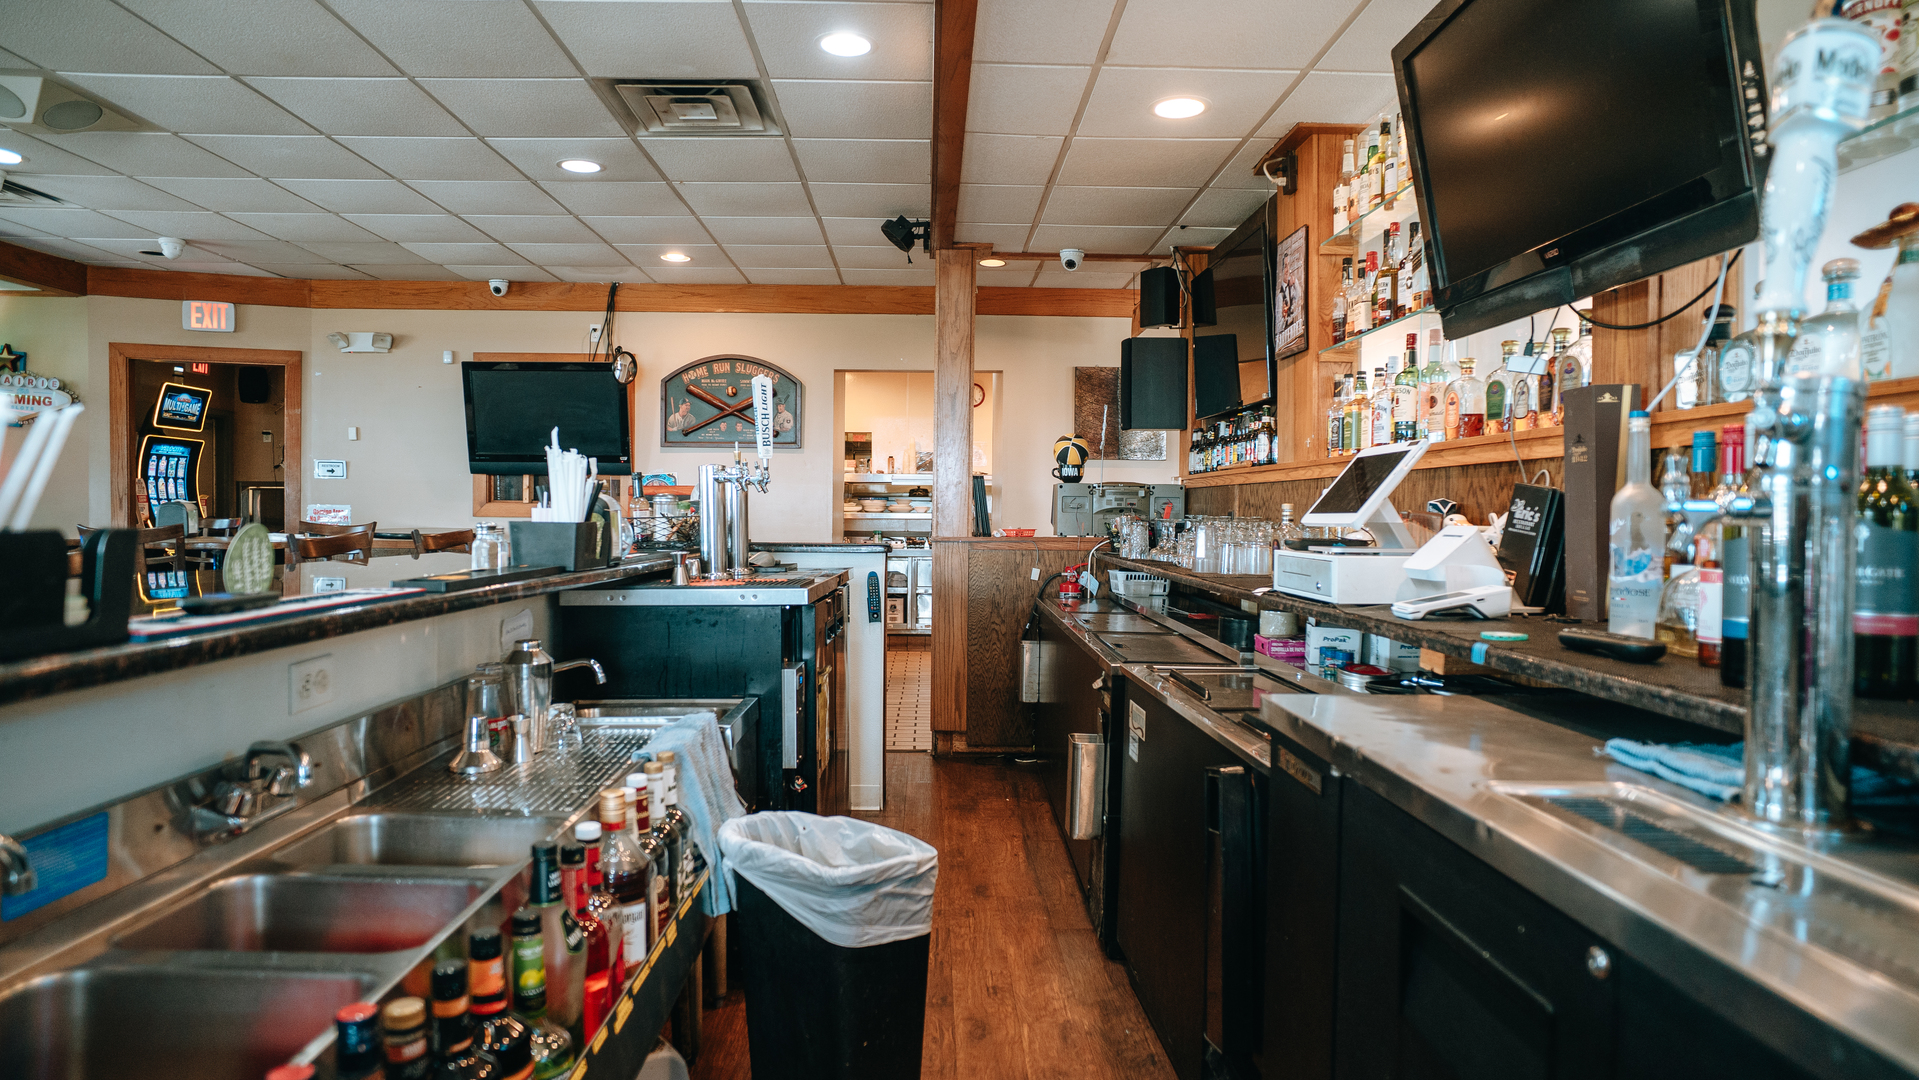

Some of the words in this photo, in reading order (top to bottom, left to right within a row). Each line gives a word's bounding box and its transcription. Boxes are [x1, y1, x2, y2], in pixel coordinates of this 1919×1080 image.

[191, 302, 229, 329] EXIT
[712, 362, 730, 375] RUN
[735, 362, 780, 385] SLUGGERS
[760, 383, 768, 411] LIGHT
[760, 413, 772, 447] BUSCH
[1061, 467, 1079, 477] IOWA
